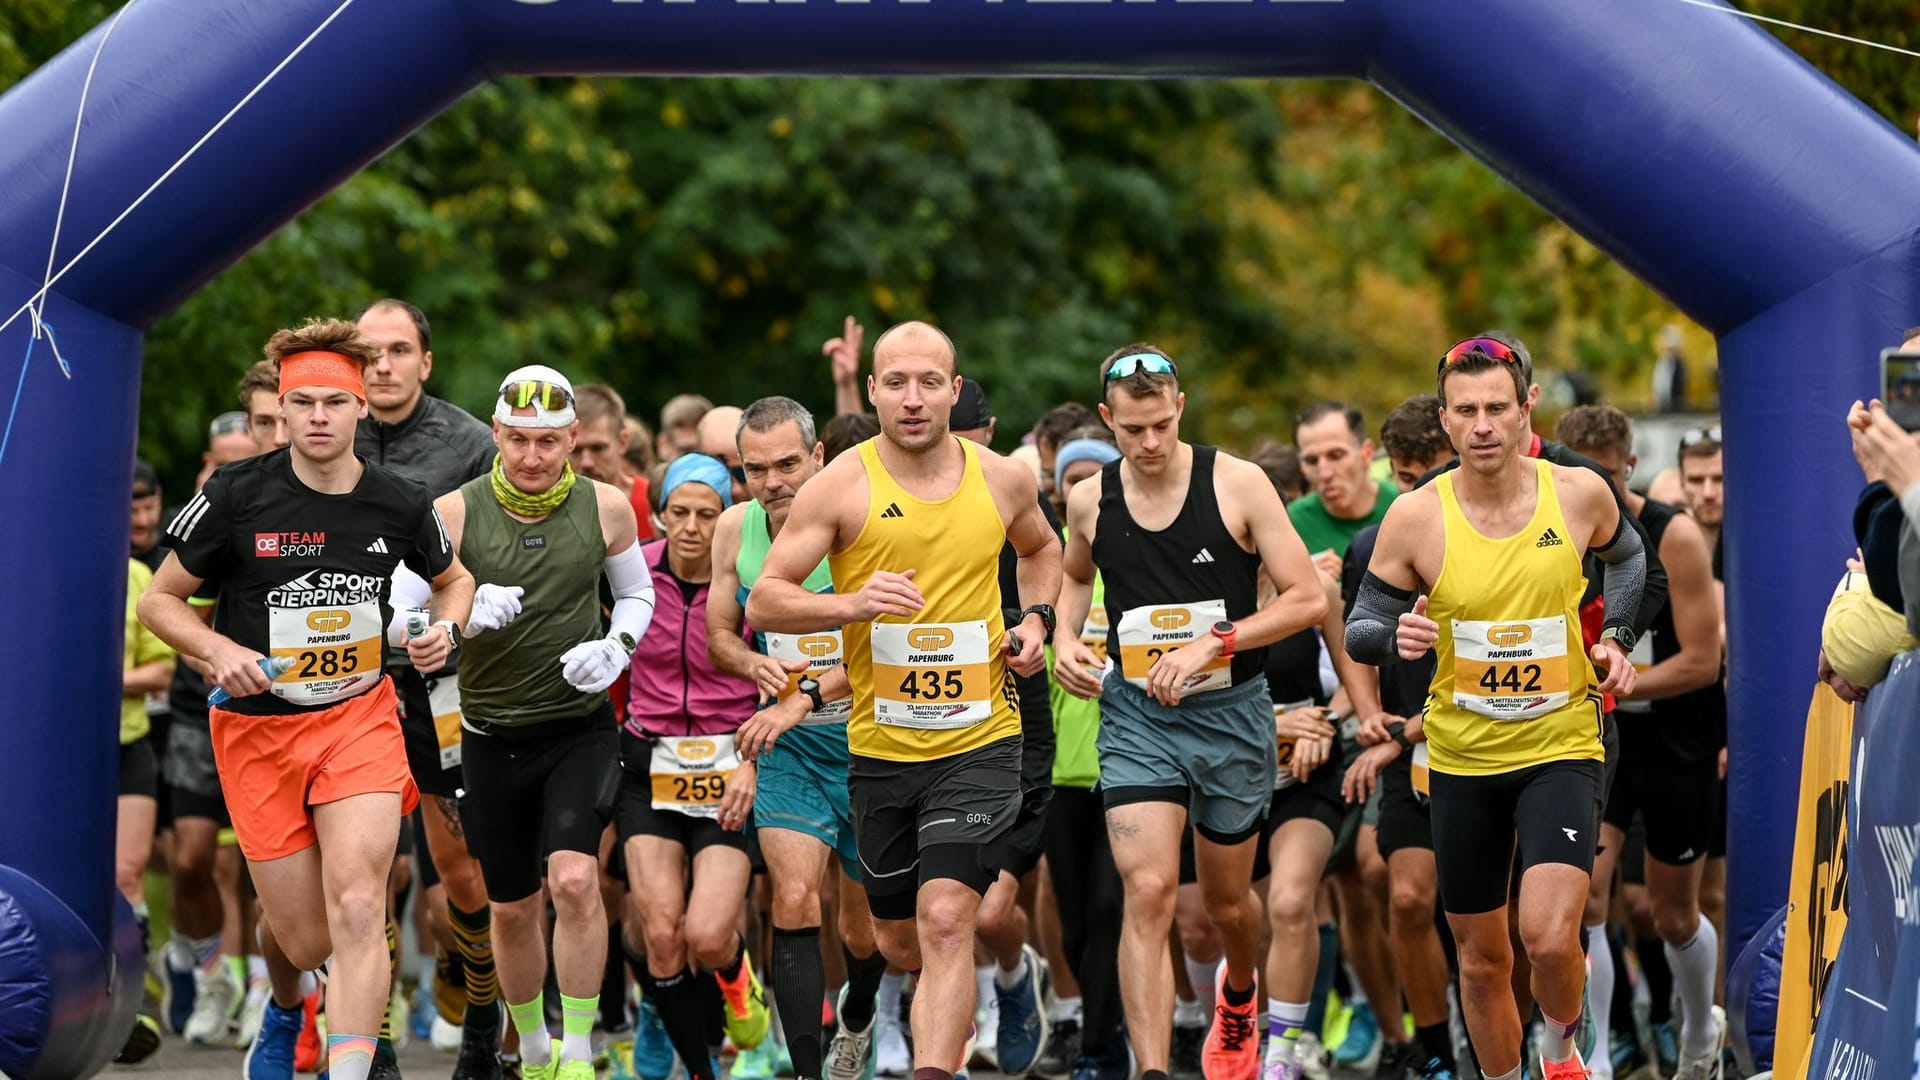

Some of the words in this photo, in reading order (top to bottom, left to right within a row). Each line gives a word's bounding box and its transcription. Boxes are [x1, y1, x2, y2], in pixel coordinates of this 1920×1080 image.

[280, 532, 326, 544] TEAM
[1536, 538, 1563, 548] adidas
[280, 544, 325, 557] SPORT
[318, 572, 385, 593] SPORT
[266, 589, 380, 608] CIERPINSK
[307, 633, 351, 644] PAPENBURG
[1152, 631, 1194, 641] PAPENBURG
[908, 654, 954, 663] PAPENBURG
[1487, 648, 1533, 658] PAPENBURG
[298, 646, 358, 679] 285
[1479, 663, 1542, 693] 442
[899, 669, 963, 700] 435
[673, 775, 726, 801] 259
[966, 813, 992, 825] GORE
